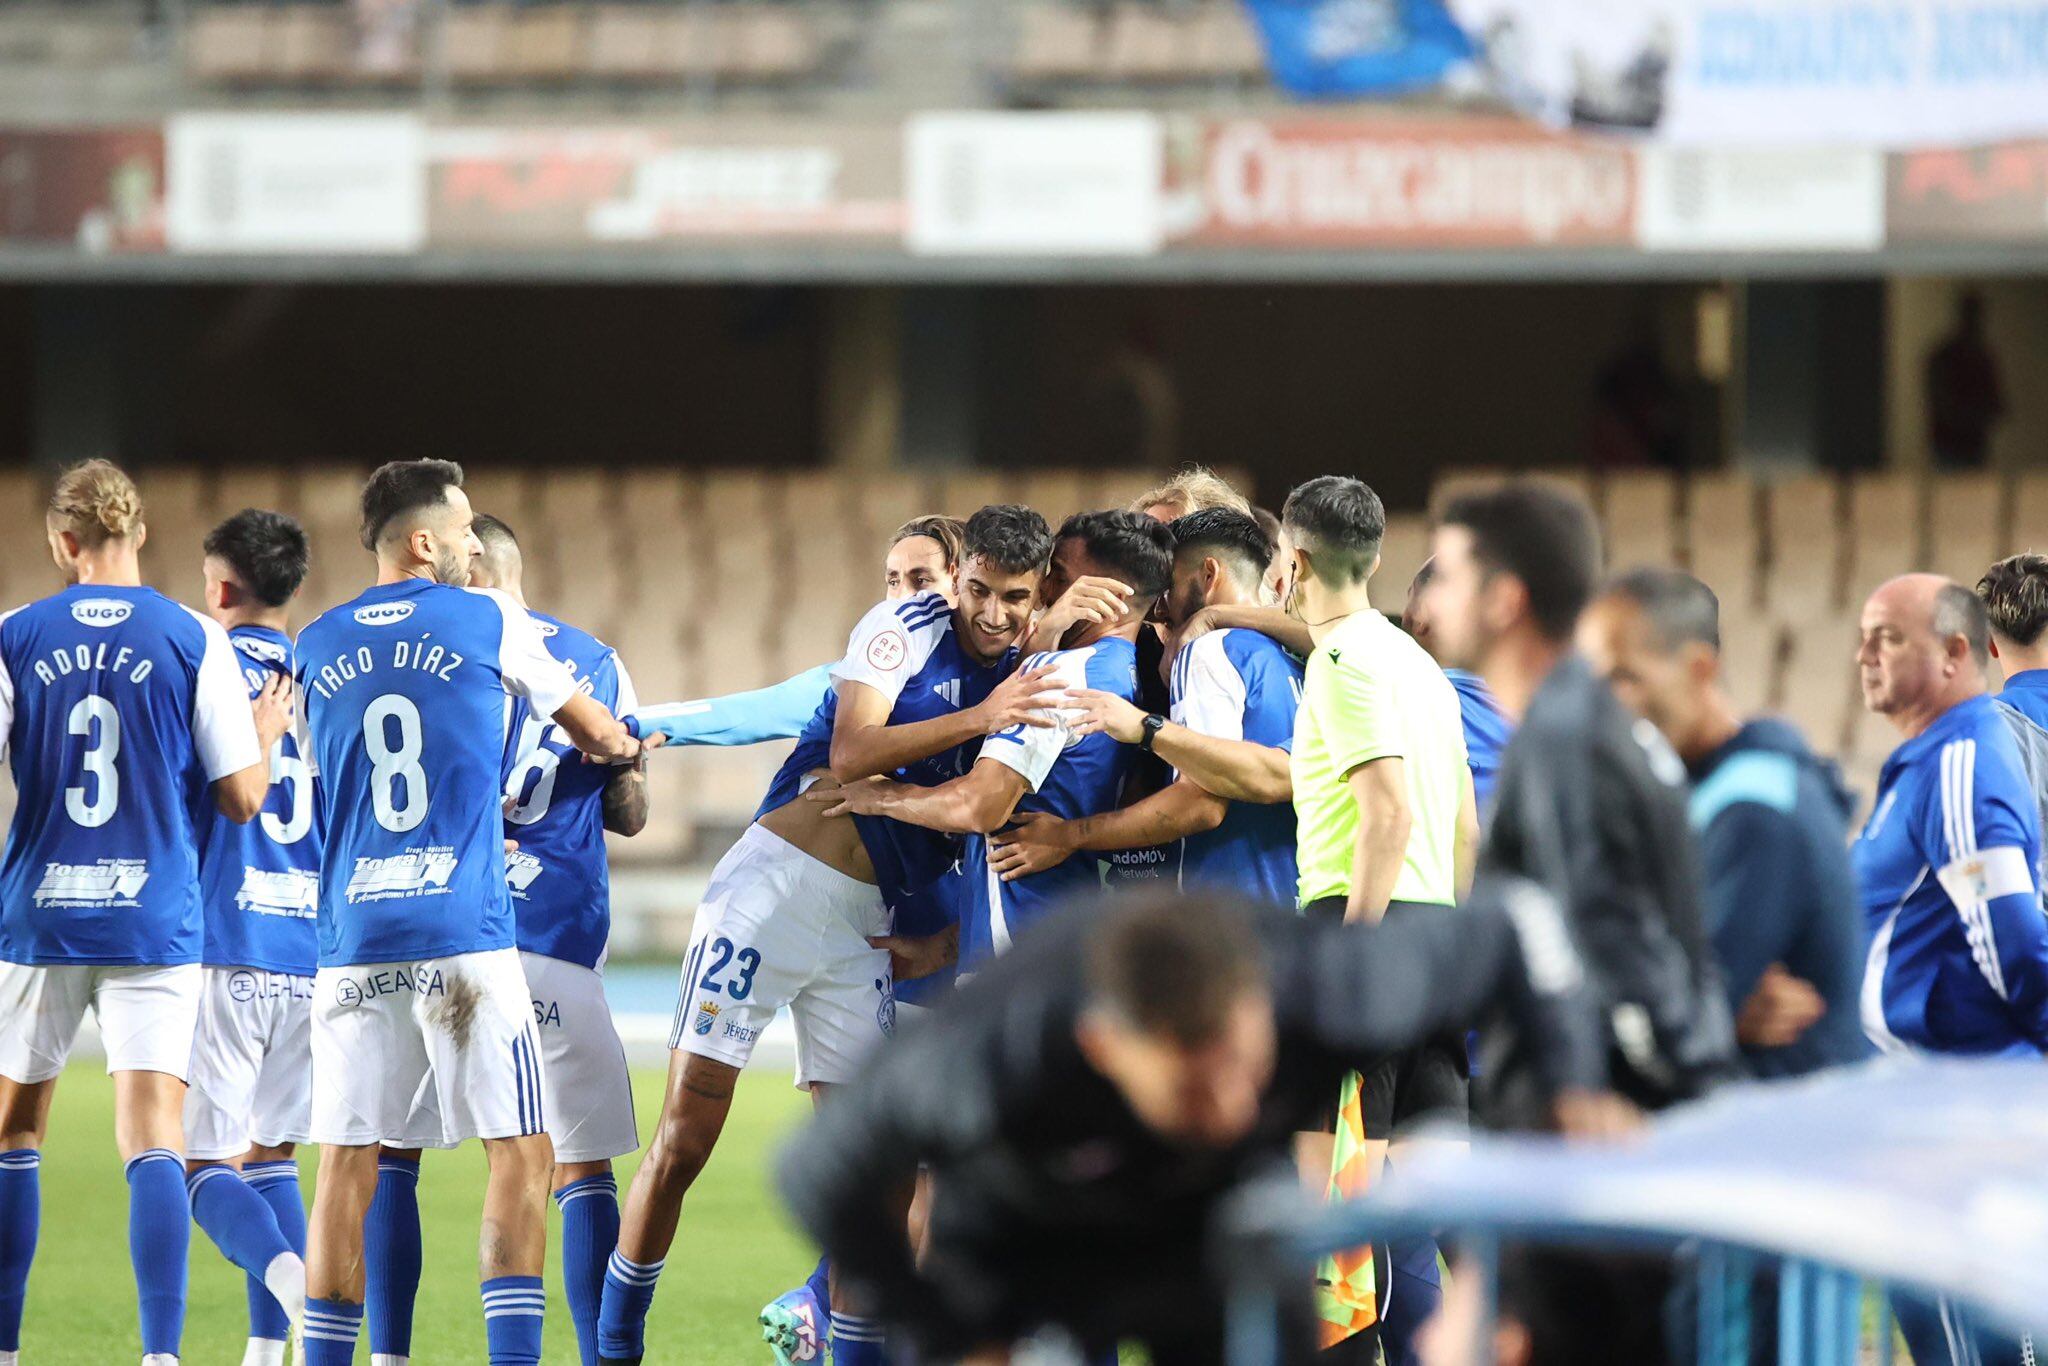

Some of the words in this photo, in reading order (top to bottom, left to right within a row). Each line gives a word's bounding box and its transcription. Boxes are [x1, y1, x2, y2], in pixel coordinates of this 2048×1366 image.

[76, 607, 128, 619] LUGO
[34, 642, 153, 686] ADOLFO
[312, 646, 374, 700] IAGO
[393, 632, 464, 682] DÍAZ
[65, 694, 120, 828] 3
[362, 693, 429, 833] 8
[699, 936, 762, 1001] 23
